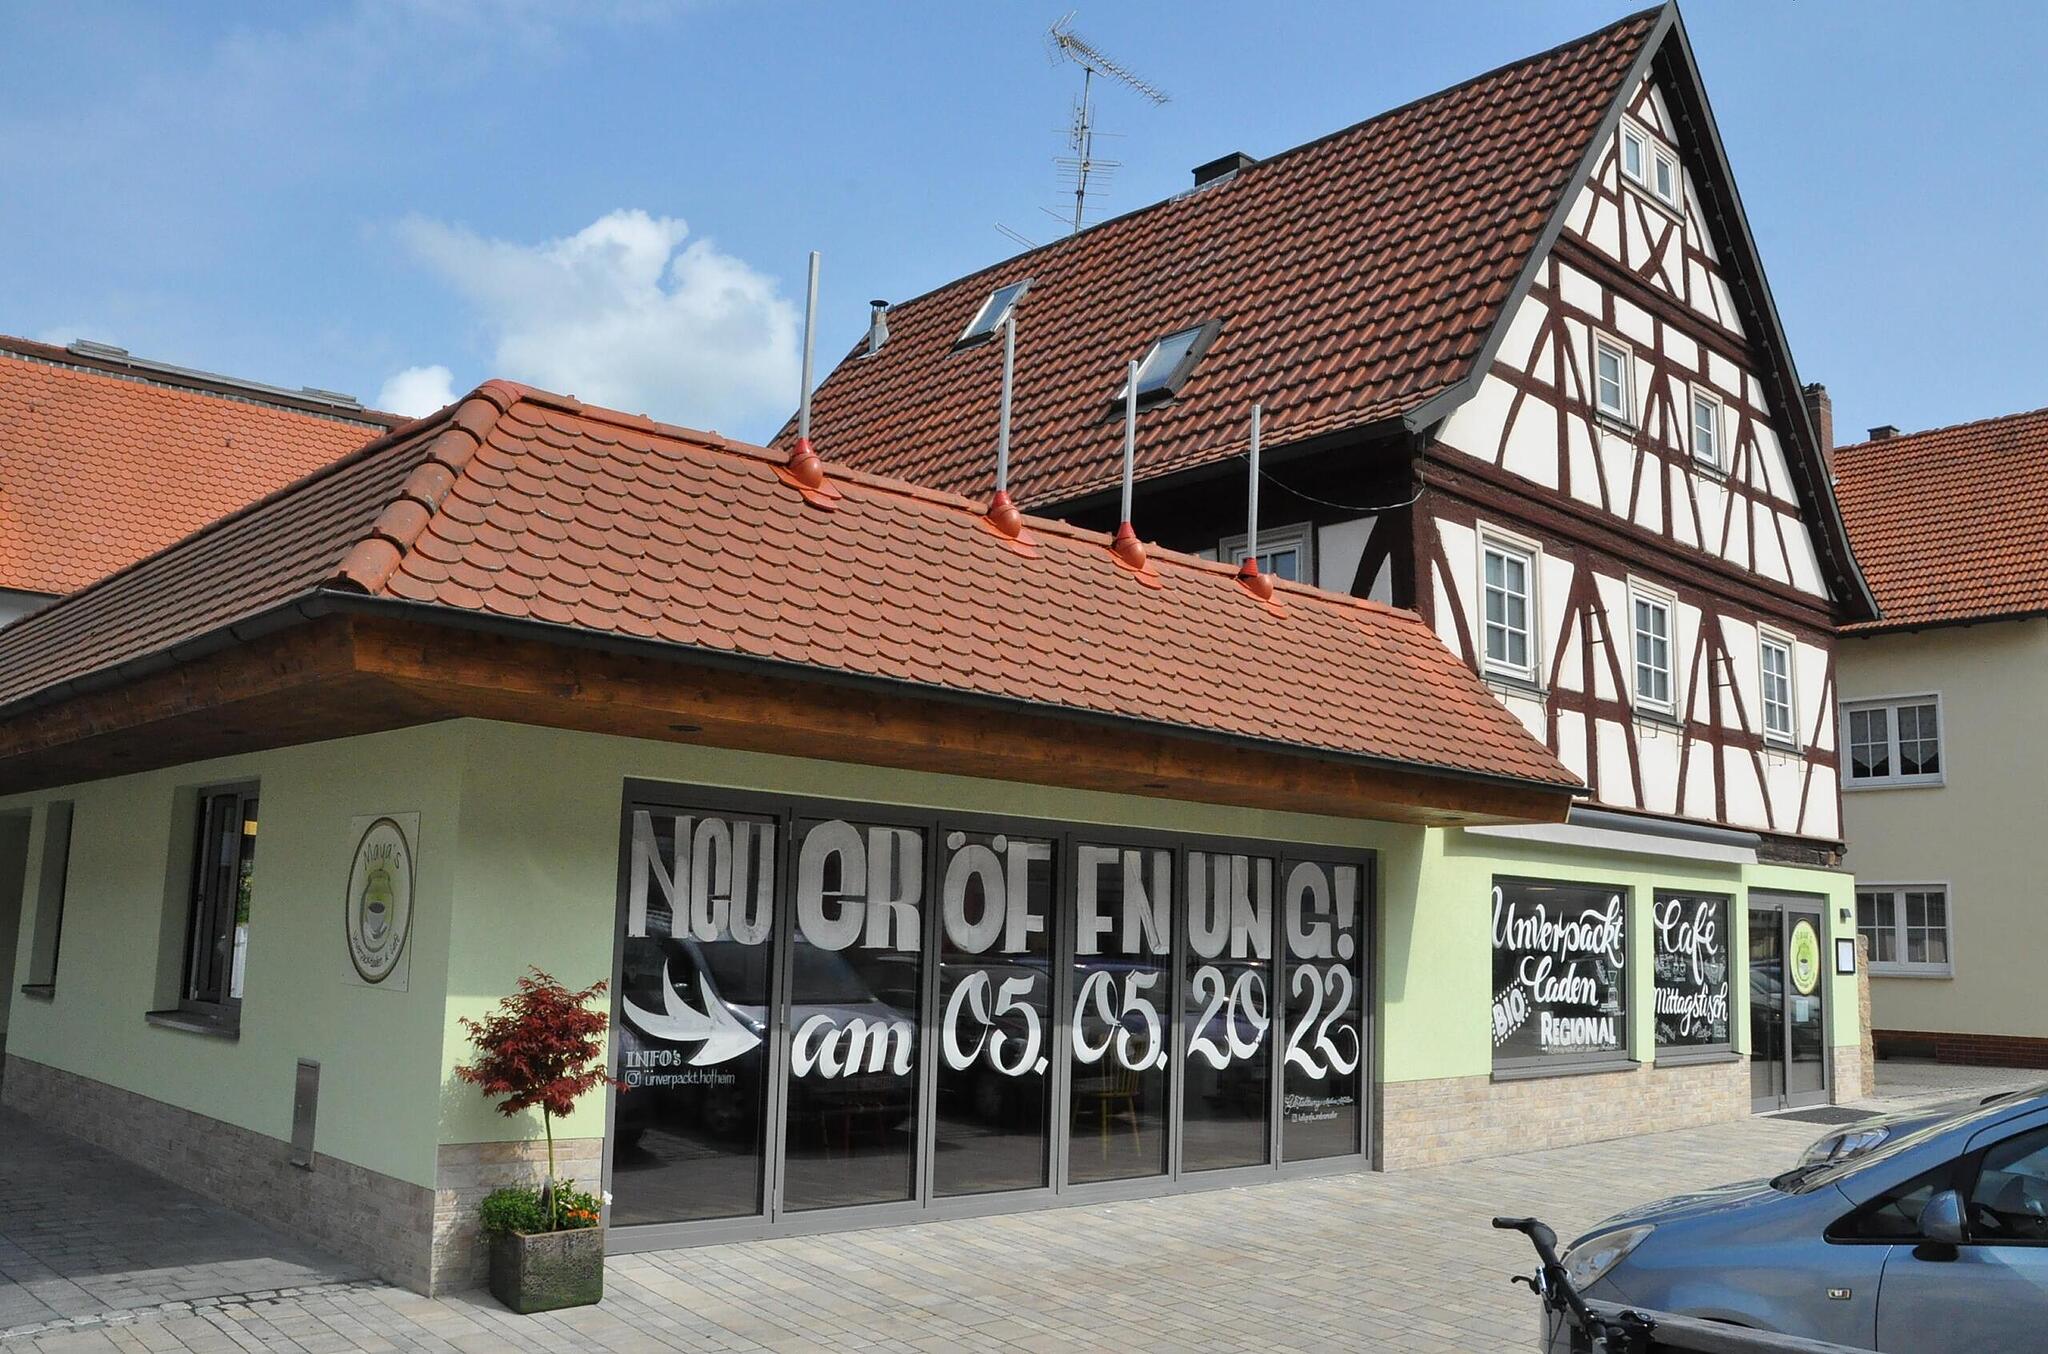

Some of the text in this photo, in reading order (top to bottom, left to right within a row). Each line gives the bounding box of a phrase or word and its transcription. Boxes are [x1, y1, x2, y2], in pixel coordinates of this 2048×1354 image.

[363, 843, 401, 871] Maya's
[1653, 898, 1718, 986] Café
[1519, 955, 1599, 1006] Laden
[1493, 988, 1526, 1037] BIO
[1541, 1011, 1617, 1046] REGIONAL
[1653, 981, 1729, 1037] Mittagstisch
[625, 1049, 682, 1068] INFO's
[792, 1014, 914, 1079] am
